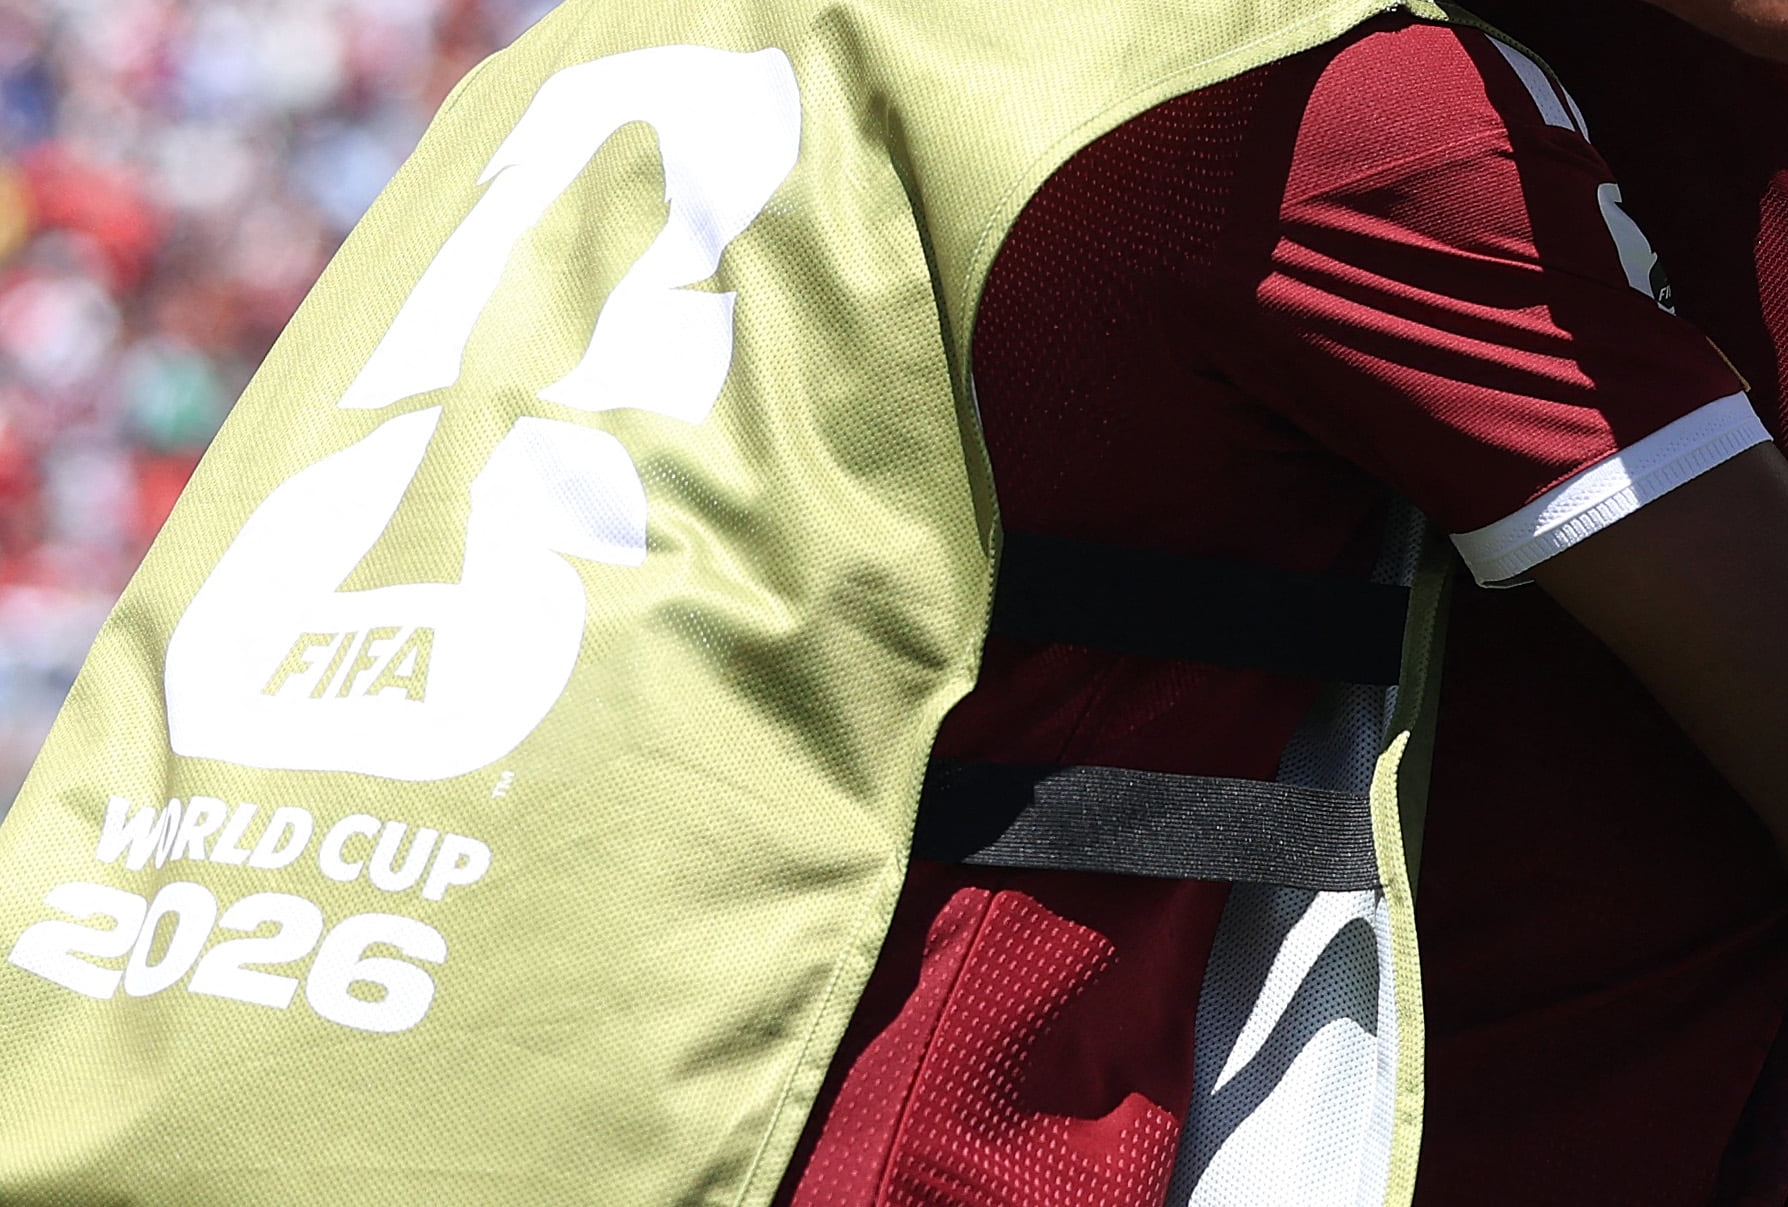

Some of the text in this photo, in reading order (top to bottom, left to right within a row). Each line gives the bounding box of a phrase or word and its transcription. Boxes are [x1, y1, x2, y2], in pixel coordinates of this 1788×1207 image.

[260, 625, 436, 703] FIFA
[96, 794, 491, 901] WORLD CUP
[7, 880, 448, 1033] 2026
